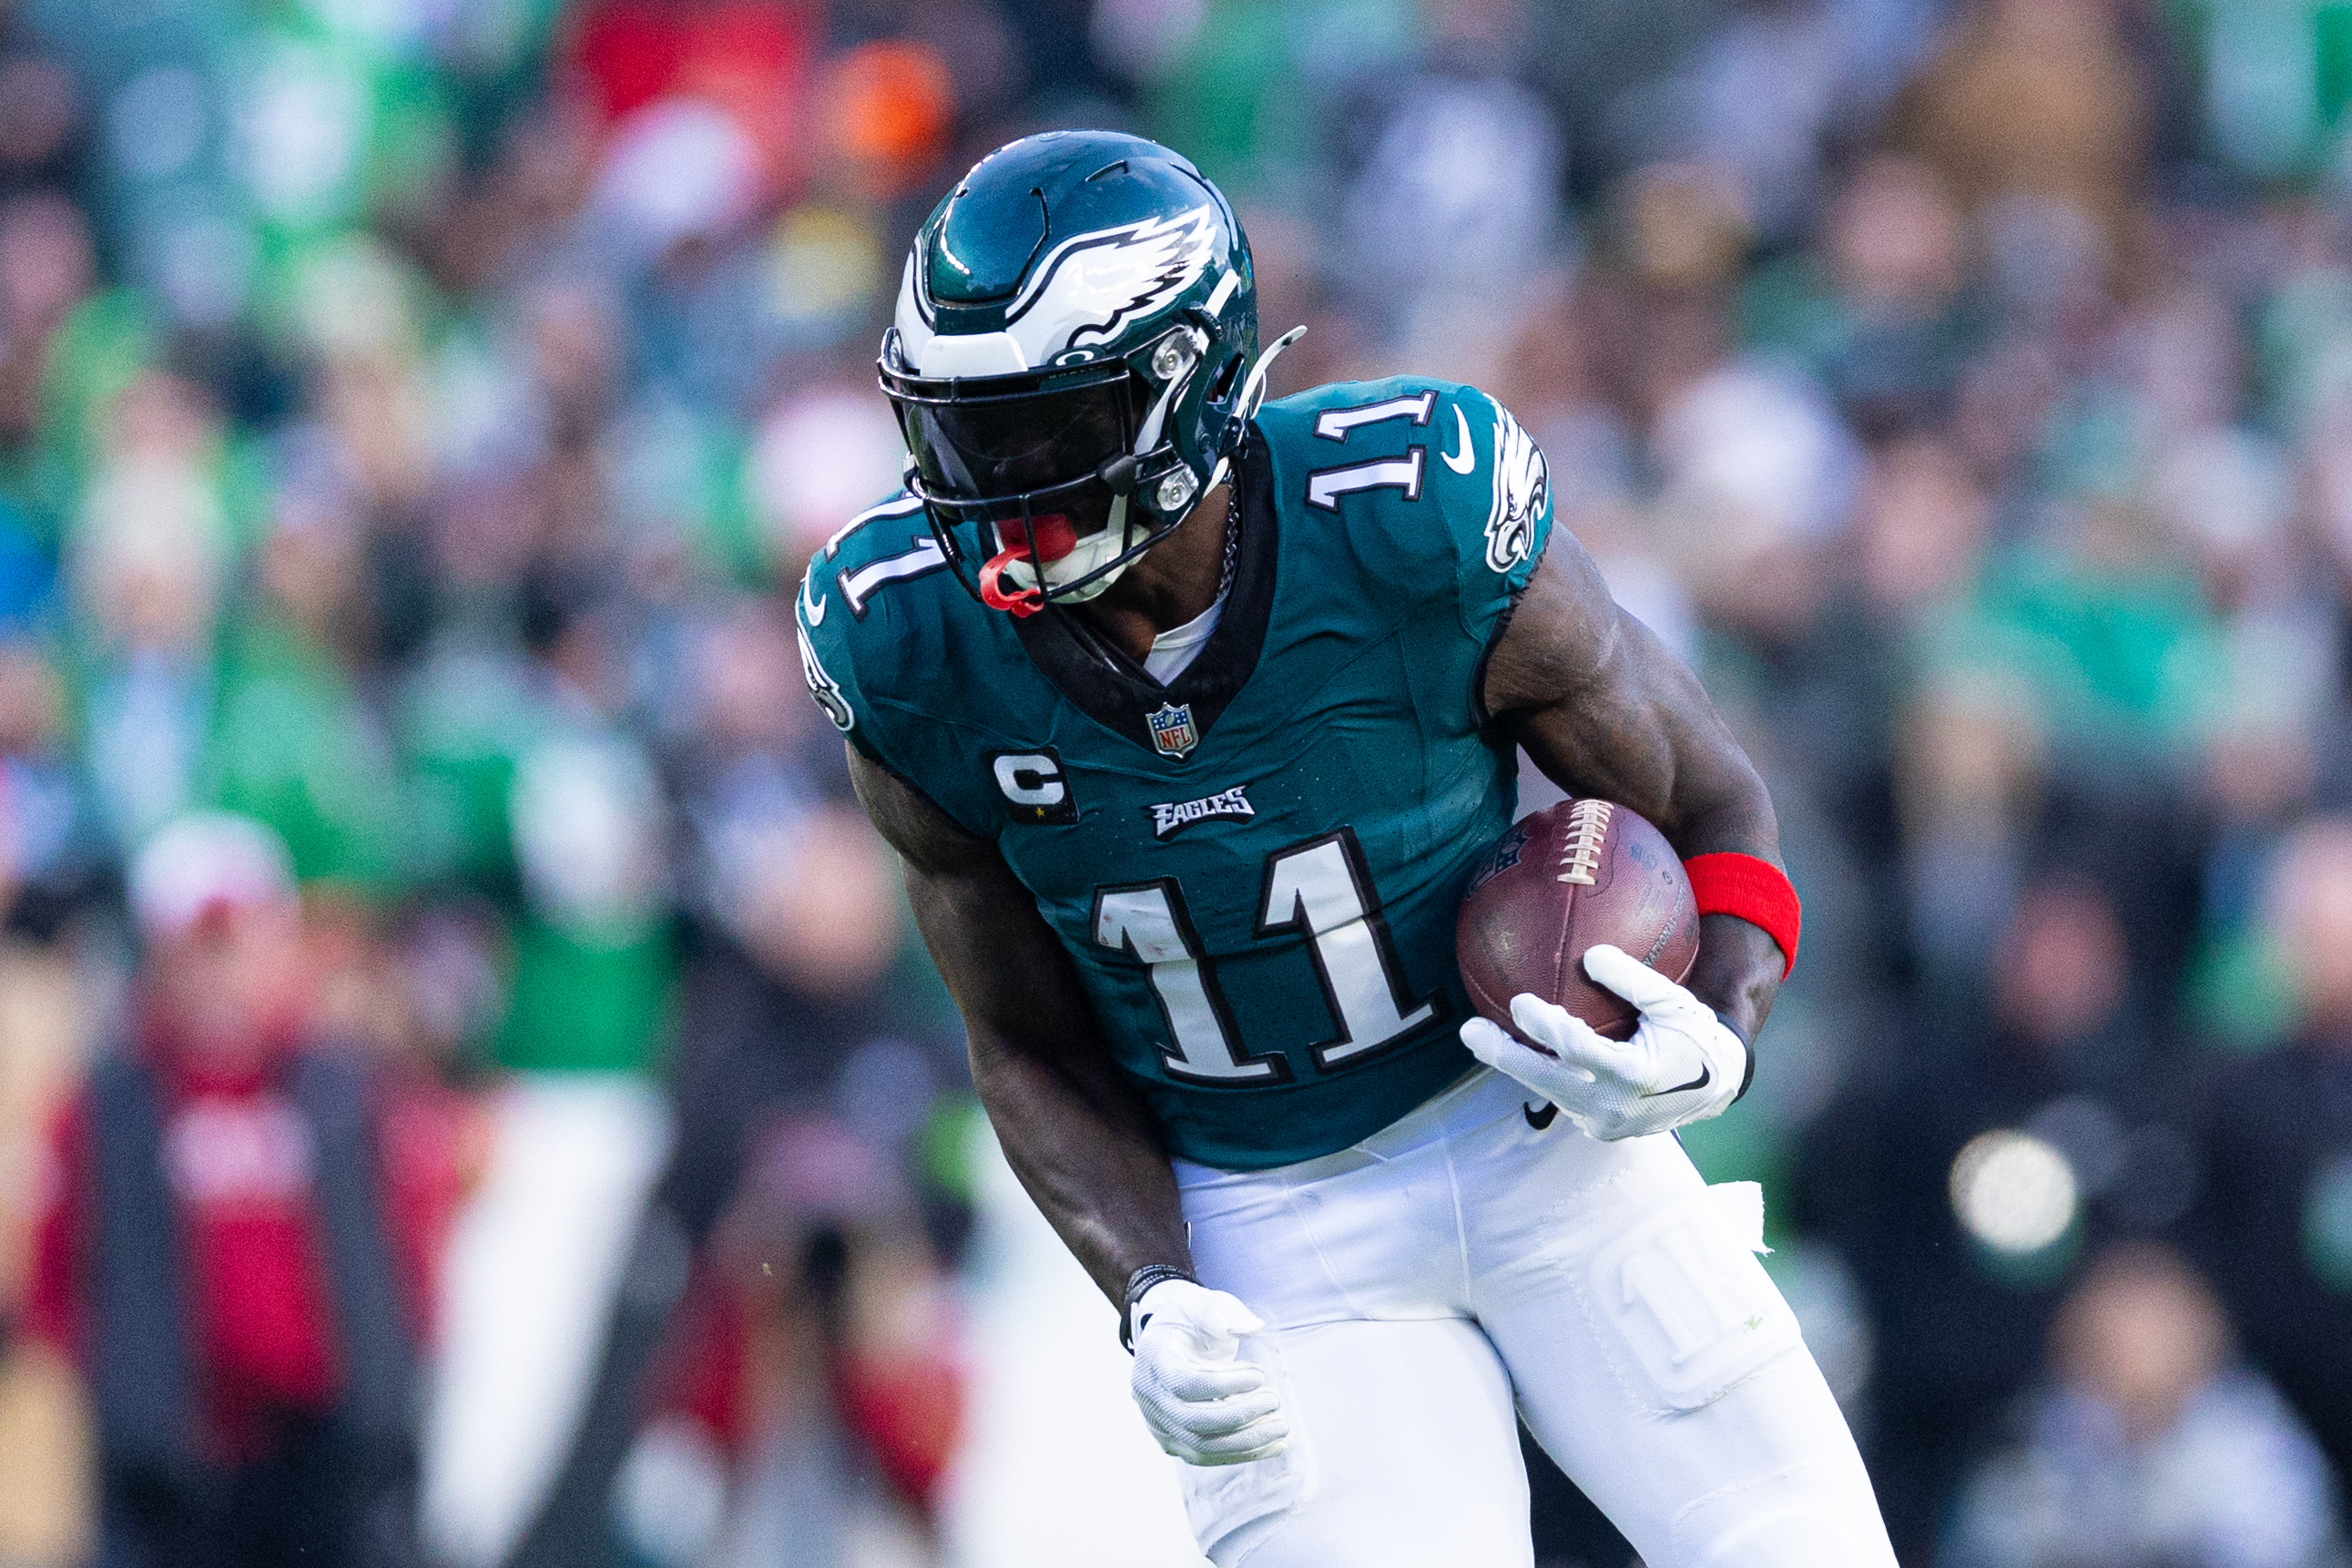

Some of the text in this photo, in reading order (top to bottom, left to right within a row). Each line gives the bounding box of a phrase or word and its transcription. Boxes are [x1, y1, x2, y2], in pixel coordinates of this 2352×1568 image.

[1306, 391, 1439, 514] 11
[1158, 727, 1191, 749] NFL
[993, 755, 1064, 805] C
[1148, 784, 1256, 837] EAGLES
[1094, 828, 1442, 1084] 11
